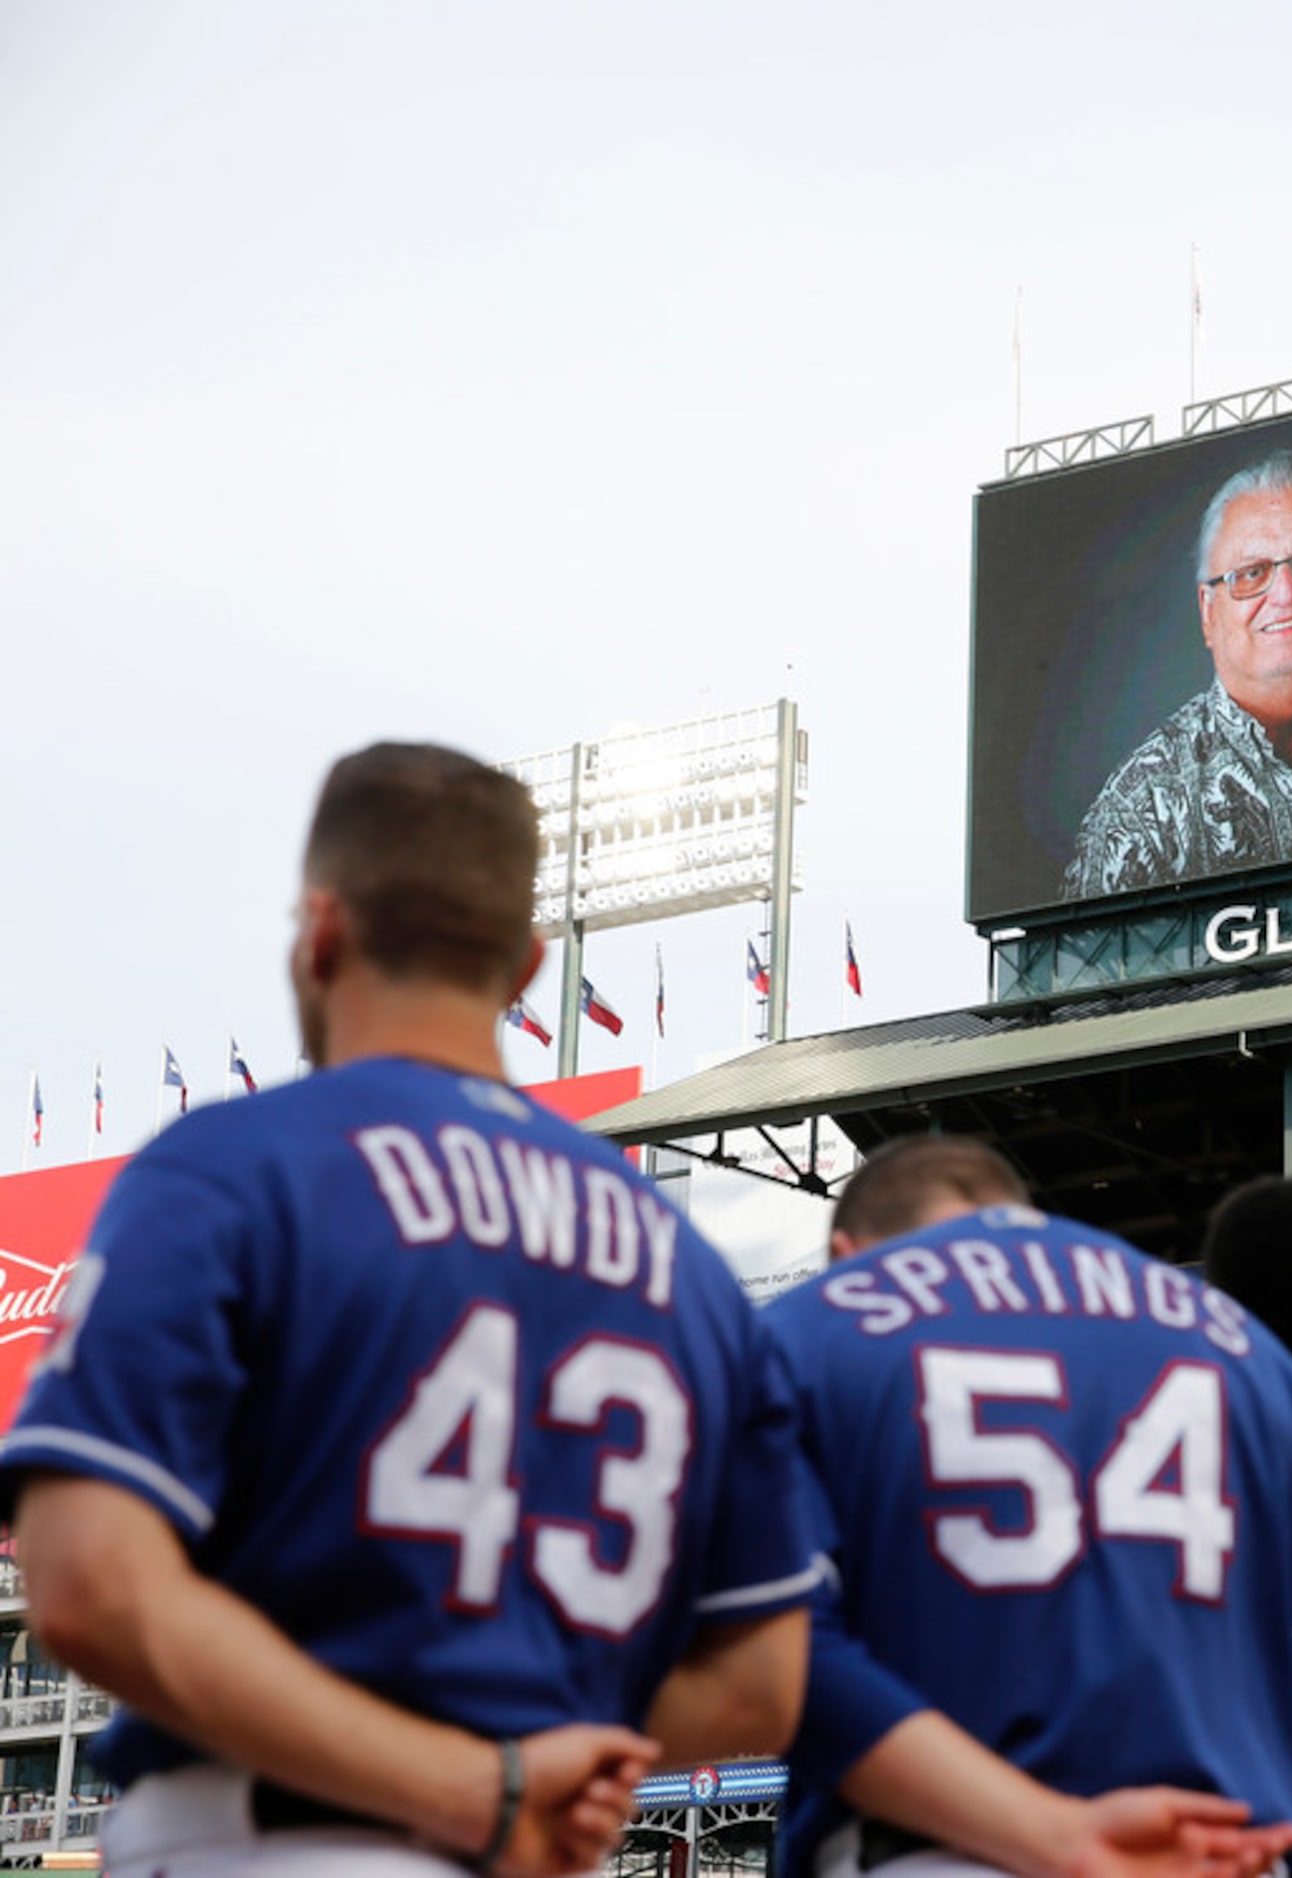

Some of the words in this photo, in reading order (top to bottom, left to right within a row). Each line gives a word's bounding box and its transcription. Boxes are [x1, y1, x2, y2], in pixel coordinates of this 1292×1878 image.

[355, 1123, 680, 1309] DOWDY
[822, 1237, 1252, 1358] SPRINGS
[357, 1301, 693, 1642] 43
[915, 1343, 1240, 1603] 54
